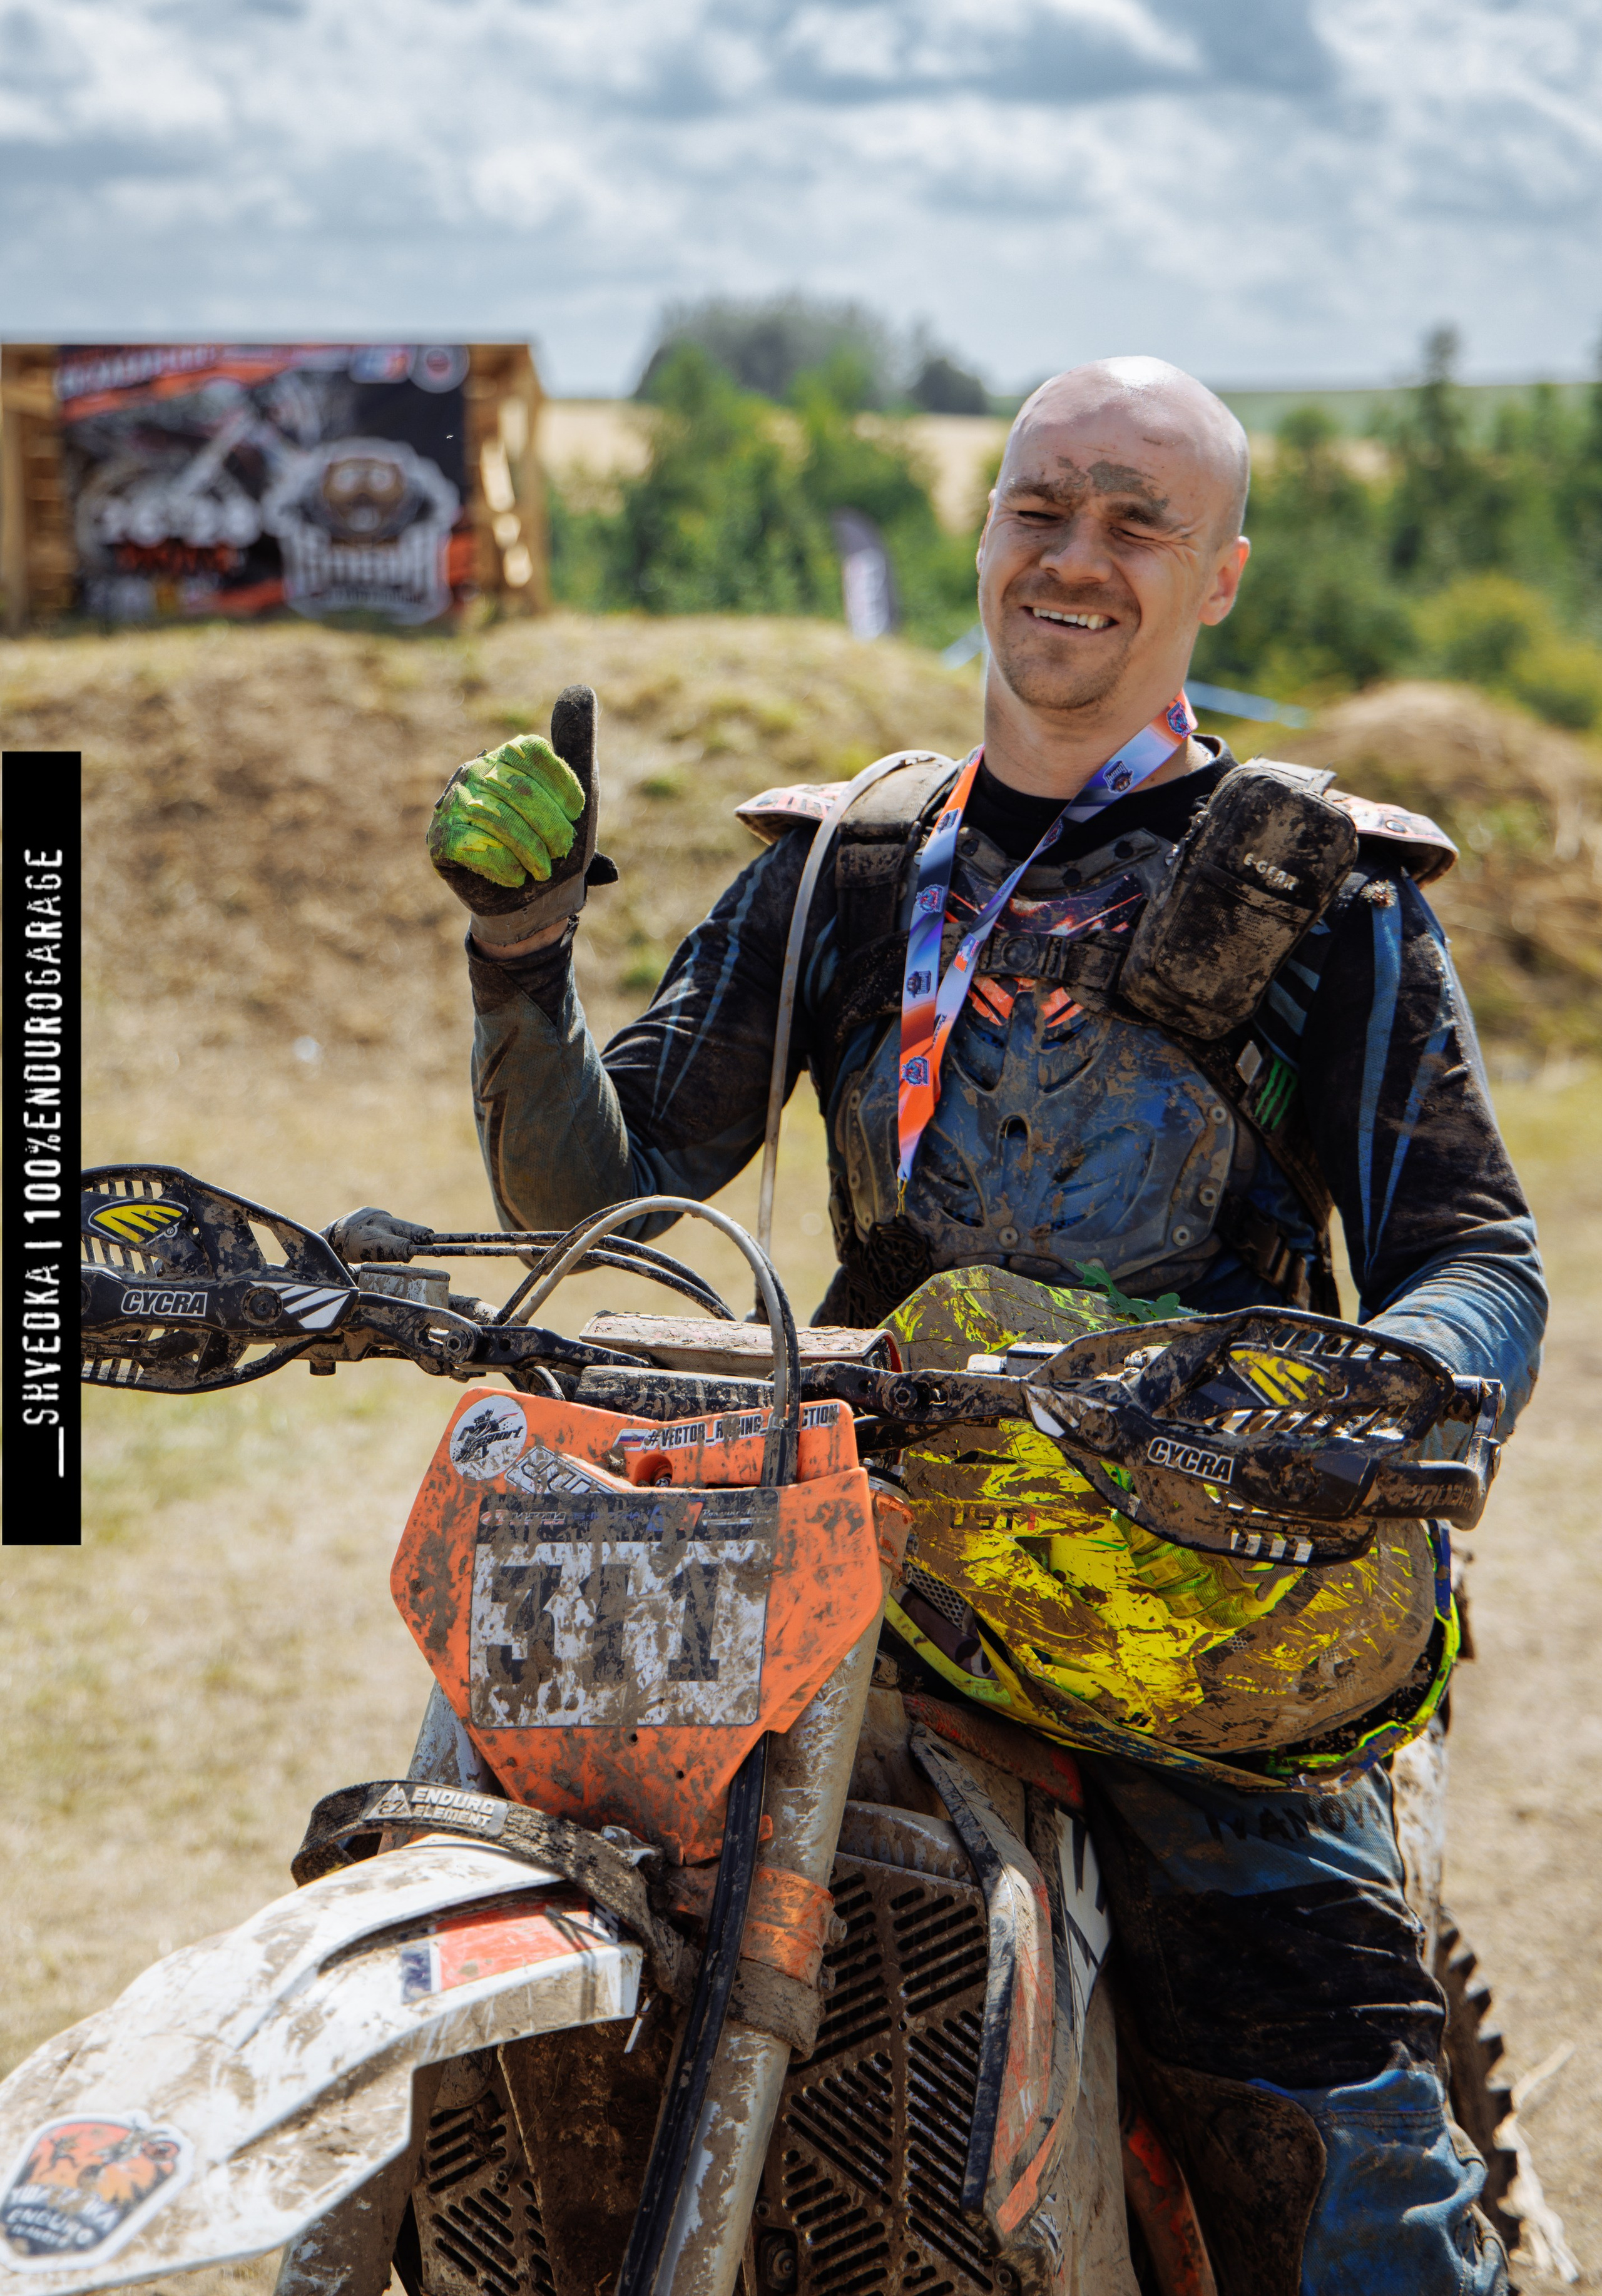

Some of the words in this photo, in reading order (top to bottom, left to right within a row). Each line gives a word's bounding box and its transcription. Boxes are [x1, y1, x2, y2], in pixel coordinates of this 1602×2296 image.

[121, 1289, 208, 1318] CYCRA
[1147, 1436, 1235, 1484] CYCRA
[411, 1786, 496, 1814] ENDURO
[412, 1804, 491, 1827] ELEMENT
